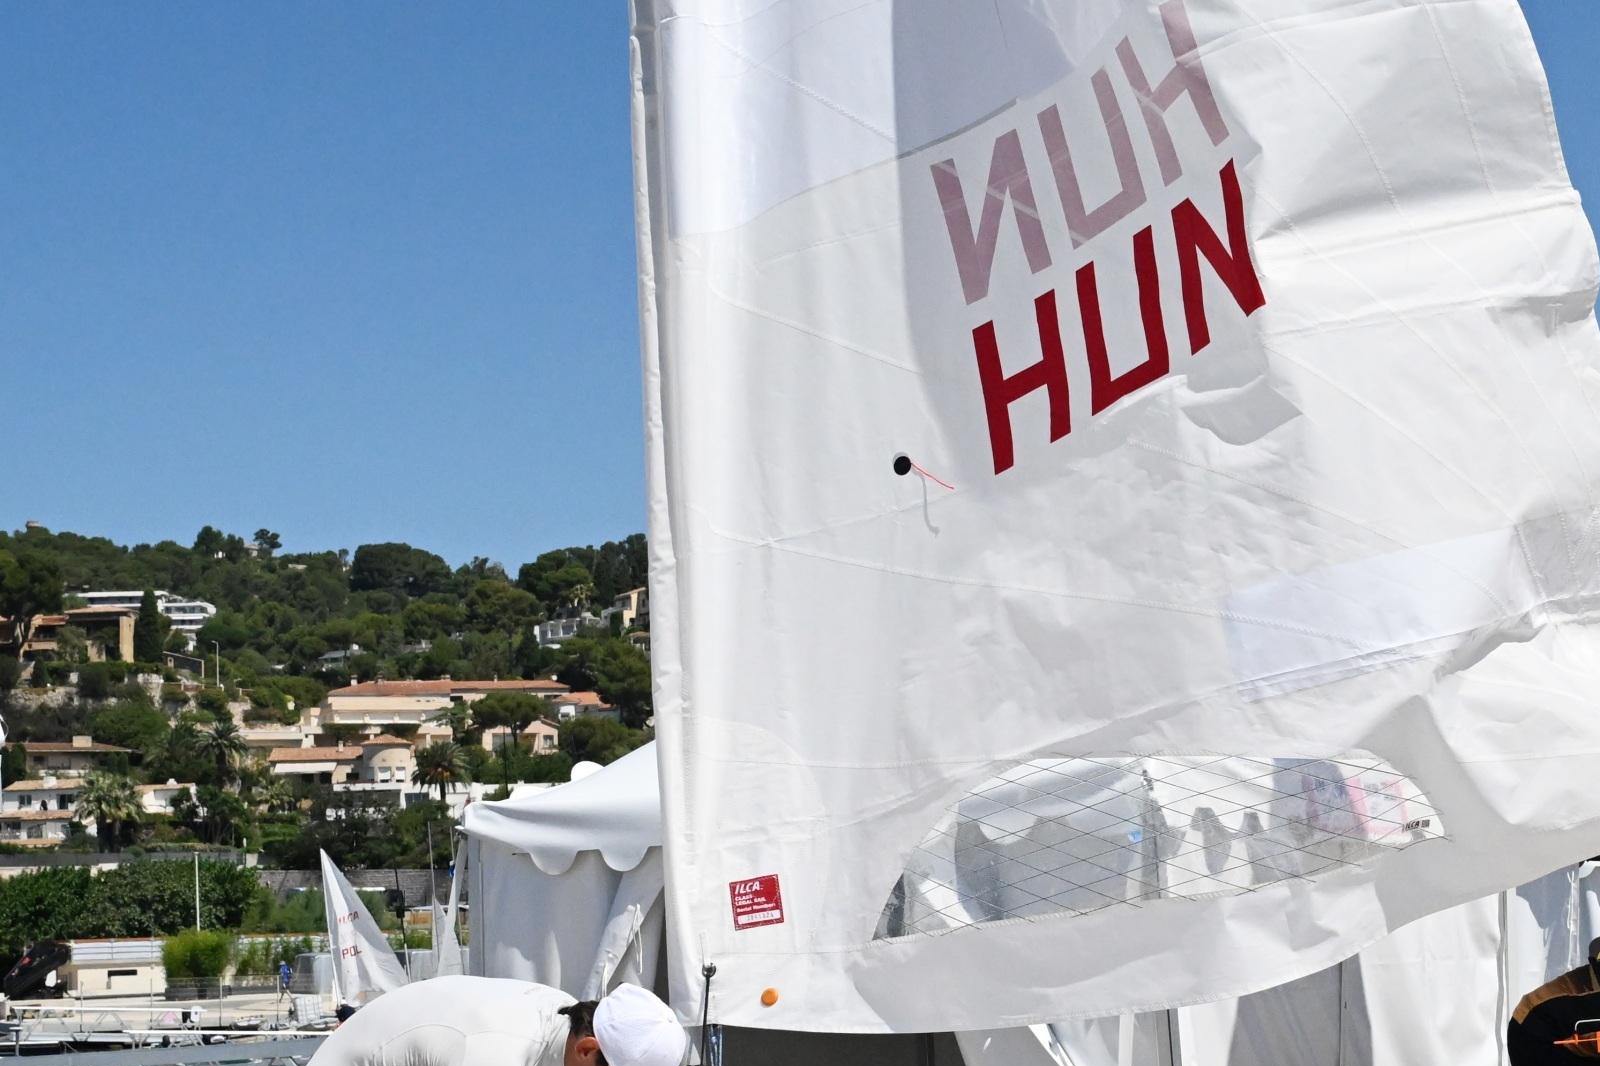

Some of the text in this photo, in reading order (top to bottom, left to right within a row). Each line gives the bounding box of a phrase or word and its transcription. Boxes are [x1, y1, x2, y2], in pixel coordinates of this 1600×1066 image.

[972, 158, 1266, 475] HUN
[1405, 820, 1420, 829] ILCA
[735, 881, 760, 895] ILCA
[339, 911, 359, 924] ILCA
[341, 944, 362, 959] POL
